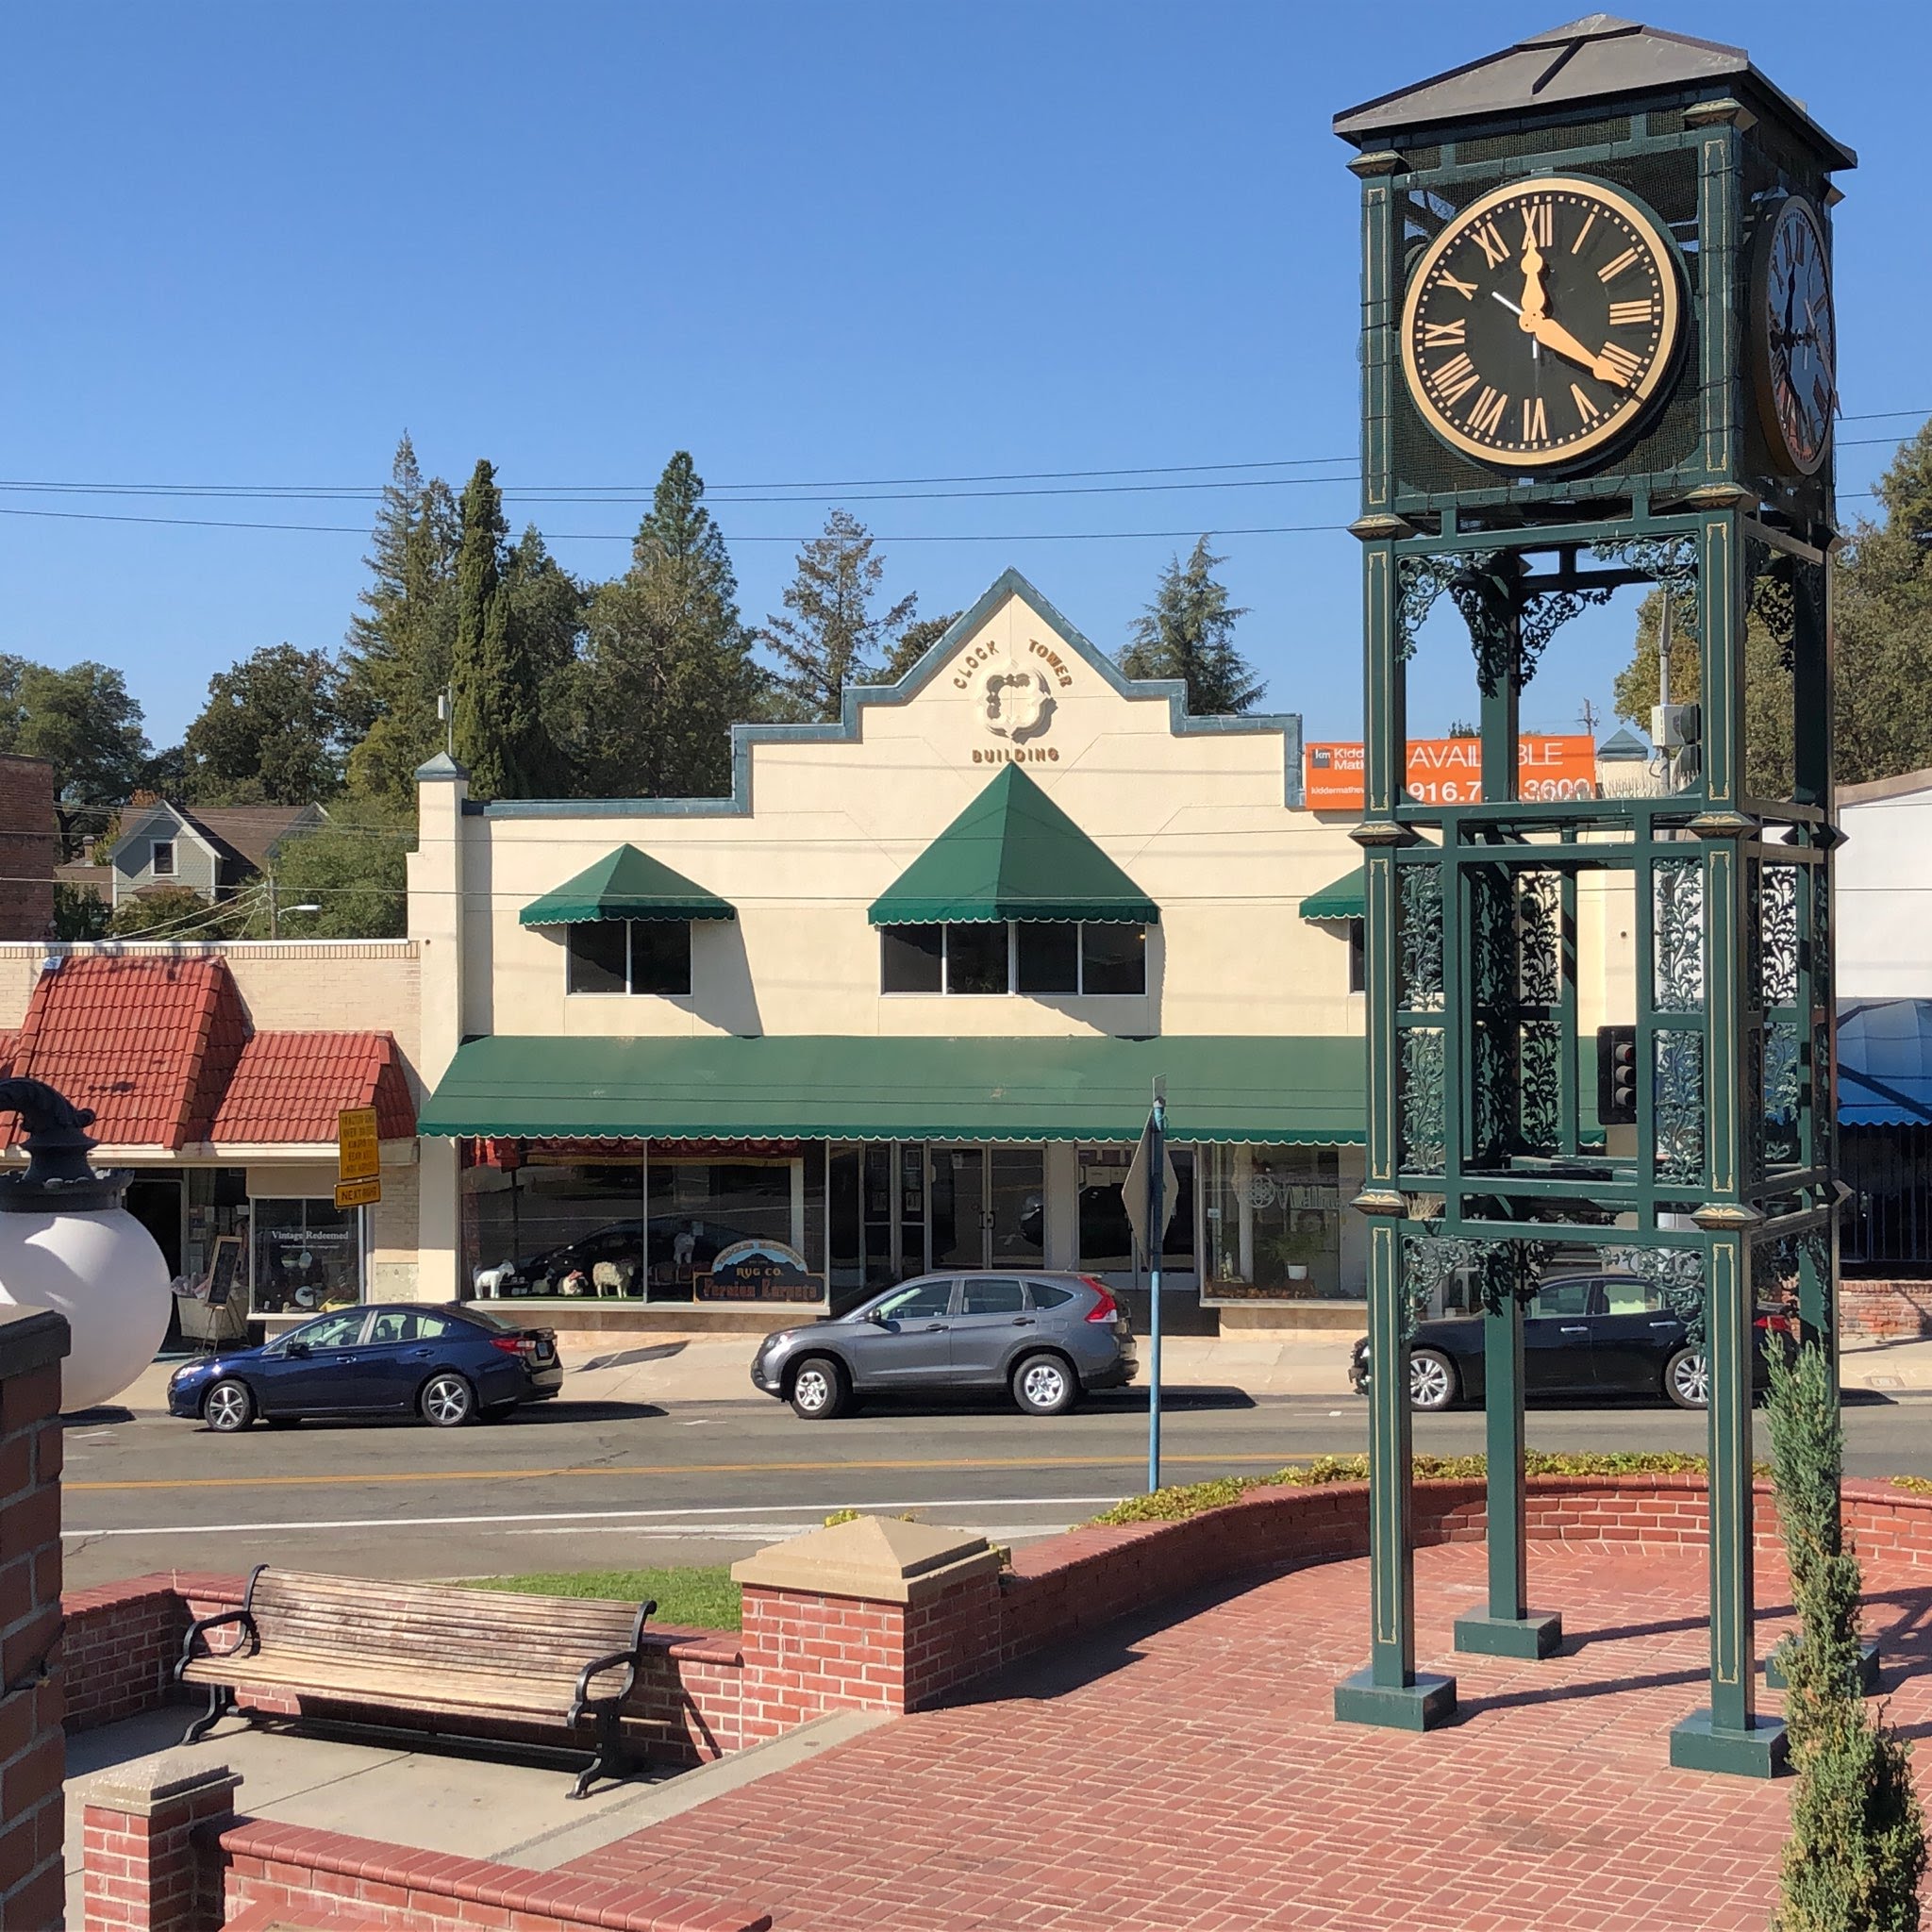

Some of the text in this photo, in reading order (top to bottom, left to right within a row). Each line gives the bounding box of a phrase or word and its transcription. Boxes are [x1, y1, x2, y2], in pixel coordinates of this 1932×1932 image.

[1522, 203, 1553, 250] XII
[1471, 222, 1511, 270] XI
[1597, 247, 1640, 283] II
[1436, 269, 1479, 301] X
[1609, 299, 1652, 325] III
[1424, 318, 1466, 347] IX
[1597, 341, 1642, 382] III
[1430, 352, 1481, 407] VIII
[1466, 386, 1507, 436] VII
[1571, 383, 1600, 424] V
[953, 638, 1074, 690] CLOCK TOWER
[972, 747, 1059, 763] BUILDING
[1315, 748, 1331, 759] km
[1334, 748, 1364, 759] Kidd
[1408, 742, 1564, 769] AVAILBLE
[341, 1189, 361, 1201] NEXT
[272, 1230, 349, 1241] Vintage Redeemed
[736, 1267, 761, 1279] RUG
